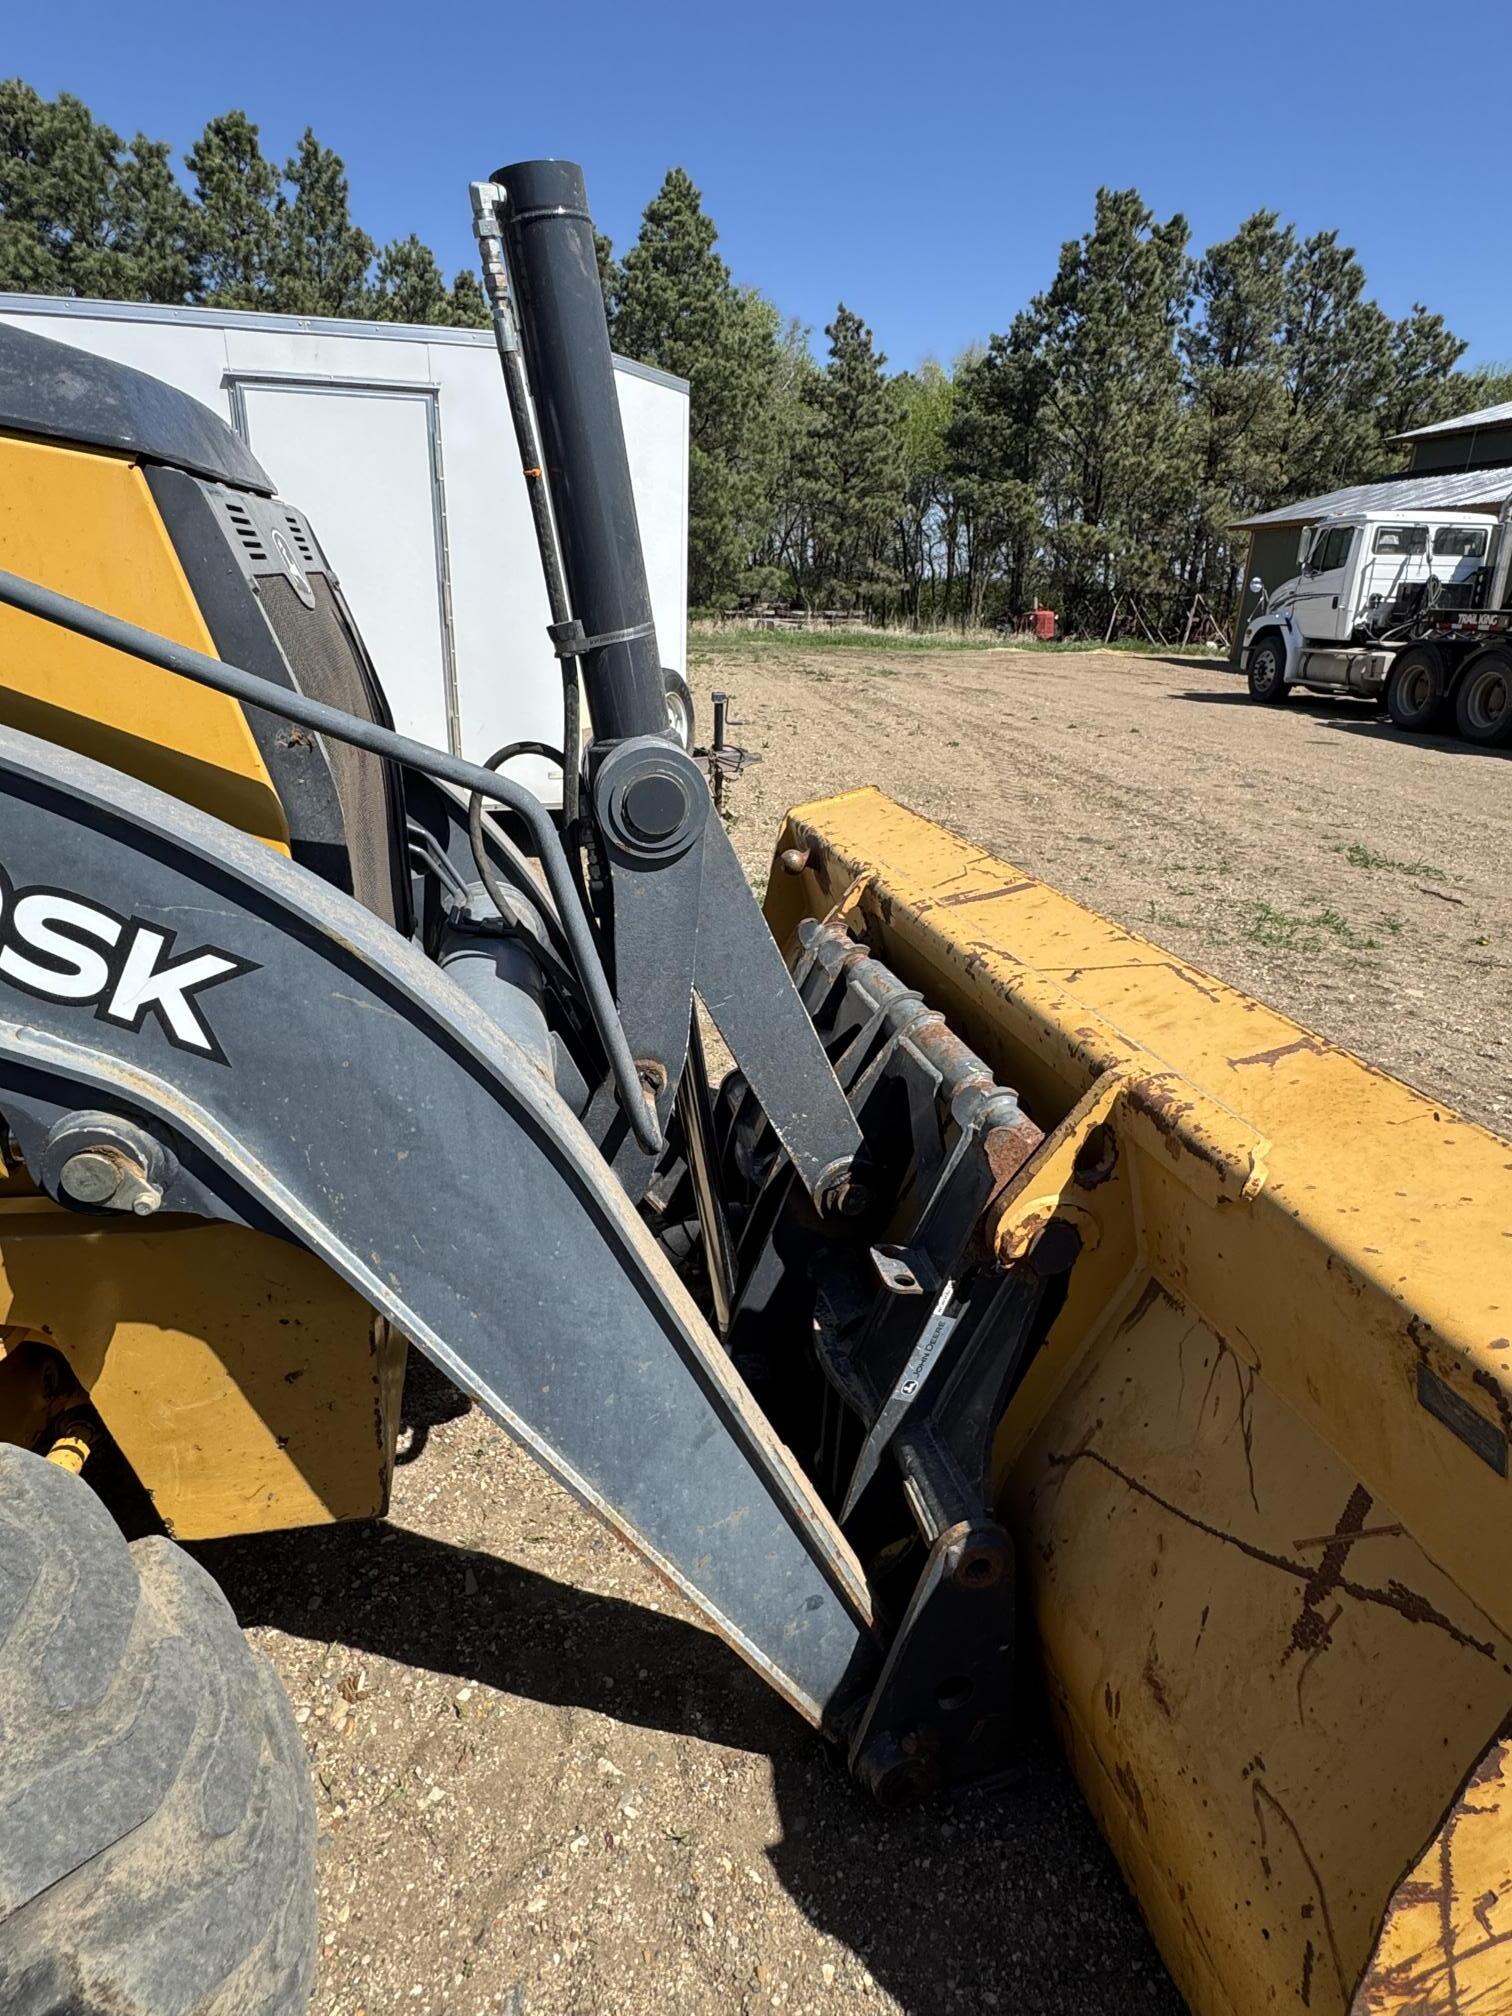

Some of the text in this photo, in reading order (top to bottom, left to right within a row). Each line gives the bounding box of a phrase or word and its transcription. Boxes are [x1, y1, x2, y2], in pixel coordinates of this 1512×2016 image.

[1458, 613, 1498, 626] TRAIL KING
[0, 886, 238, 1051] SK
[913, 1353, 930, 1379] JOHN
[925, 1321, 946, 1352] DEERE
